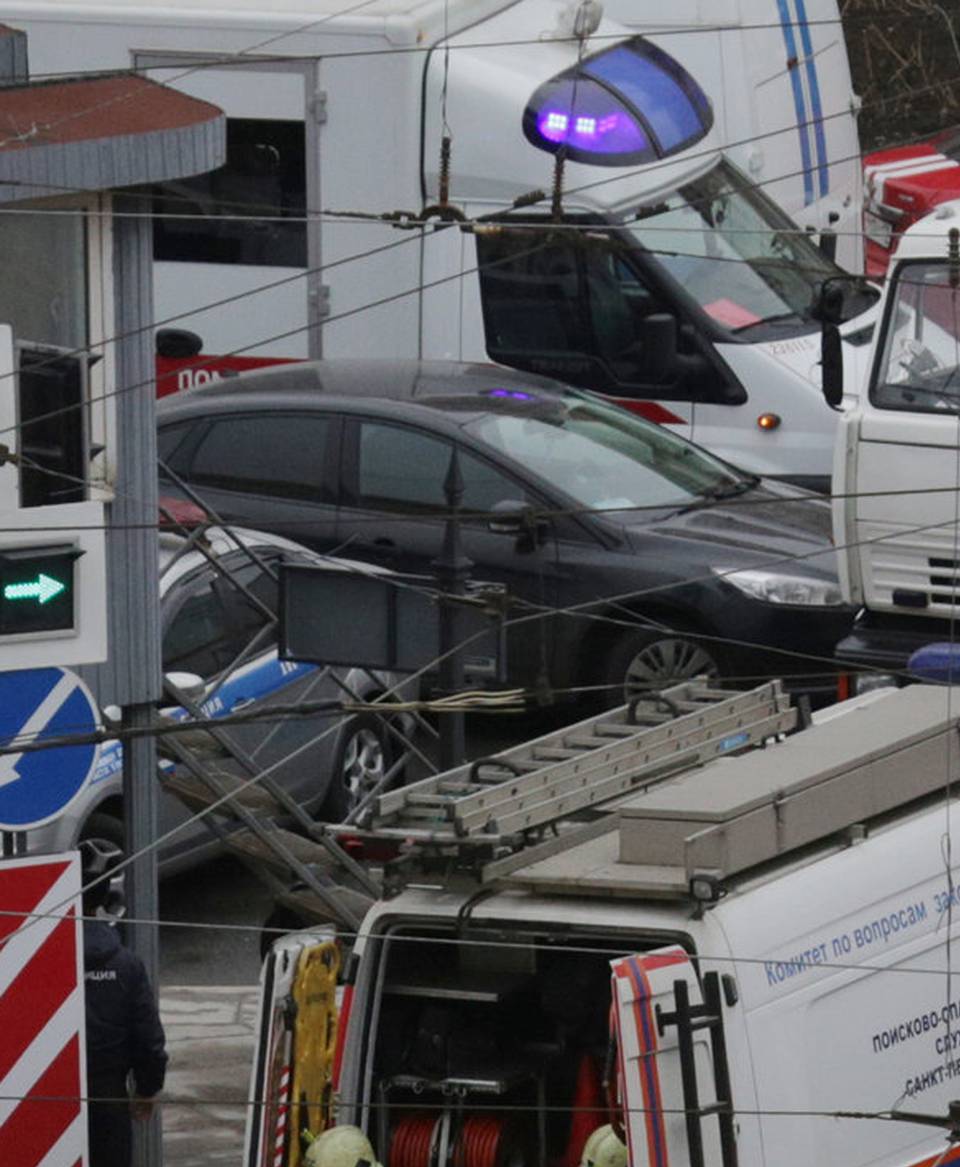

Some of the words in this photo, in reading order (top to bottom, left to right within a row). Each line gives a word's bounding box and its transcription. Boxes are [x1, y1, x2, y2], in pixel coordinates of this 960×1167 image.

[764, 943, 829, 986] Комитет
[831, 934, 852, 958] по
[853, 901, 929, 948] вопросам
